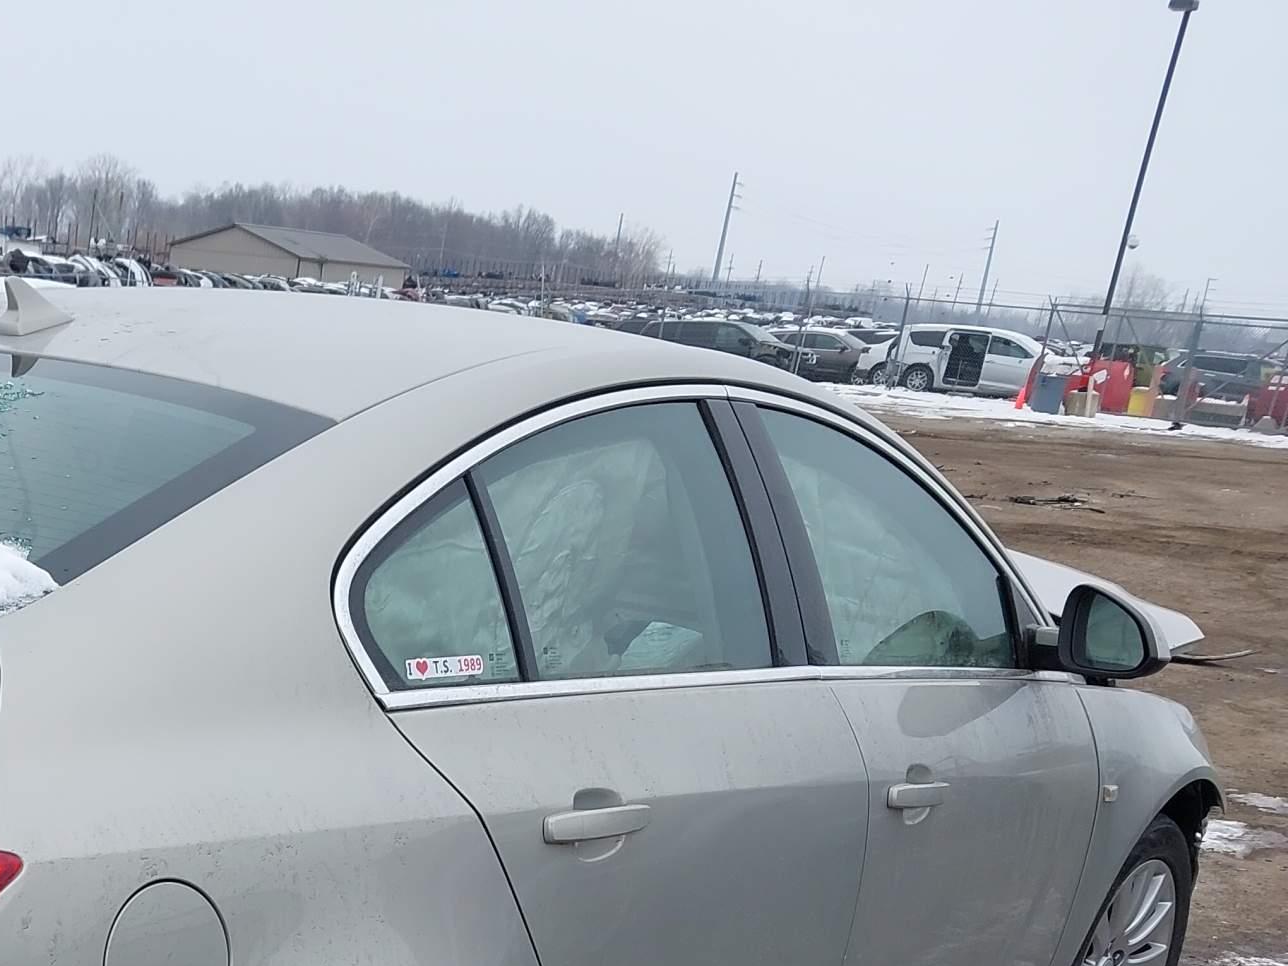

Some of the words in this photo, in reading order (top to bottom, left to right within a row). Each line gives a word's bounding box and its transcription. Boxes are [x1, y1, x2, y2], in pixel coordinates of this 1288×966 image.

[407, 662, 413, 676] I
[432, 659, 454, 674] T.S.
[457, 657, 482, 672] 1989
